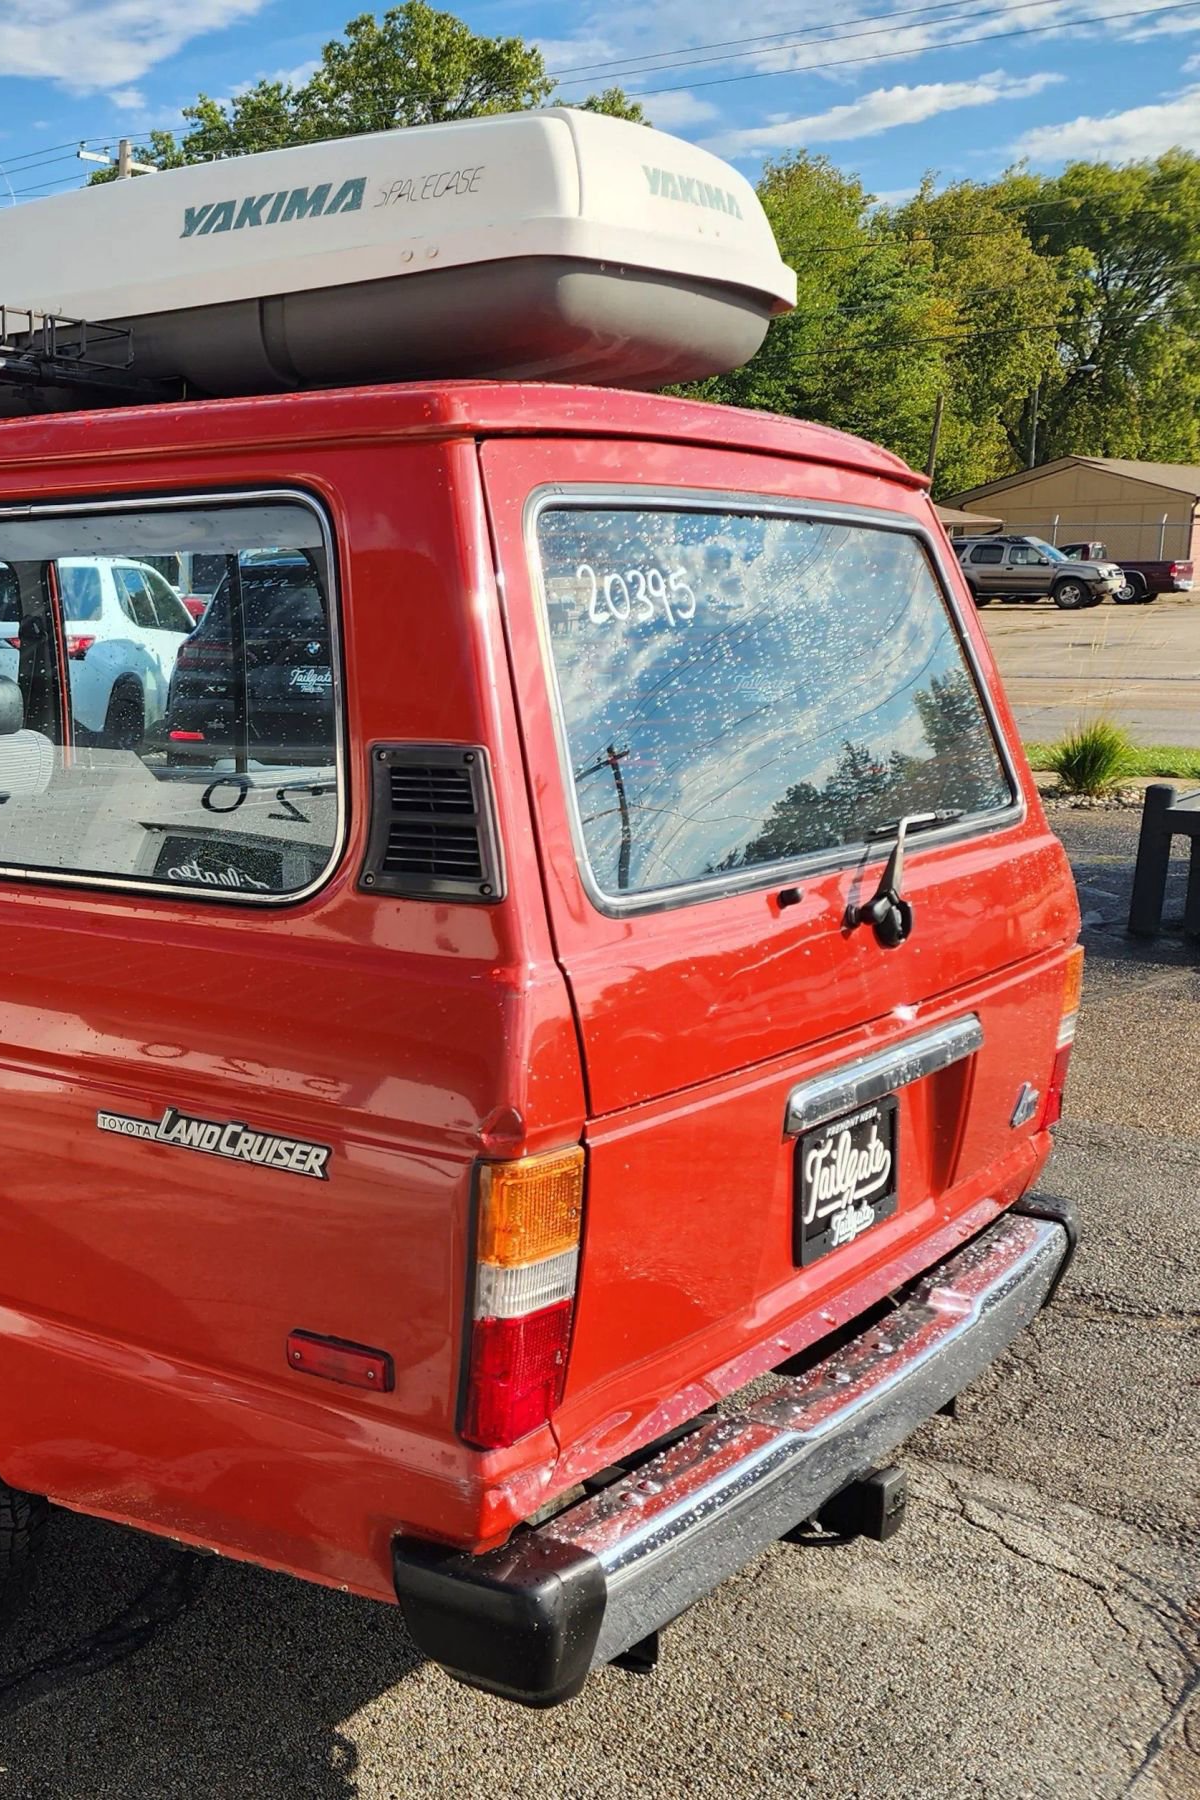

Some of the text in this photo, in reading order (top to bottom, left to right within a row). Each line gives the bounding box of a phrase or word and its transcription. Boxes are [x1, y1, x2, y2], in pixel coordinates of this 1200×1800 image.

[179, 176, 368, 239] YAKIMA
[641, 164, 745, 221] YAKIMA
[576, 564, 697, 627] 20395
[289, 668, 332, 687] Tailgat
[100, 1116, 151, 1138] TOYOTA
[804, 1130, 891, 1224] Tailgate
